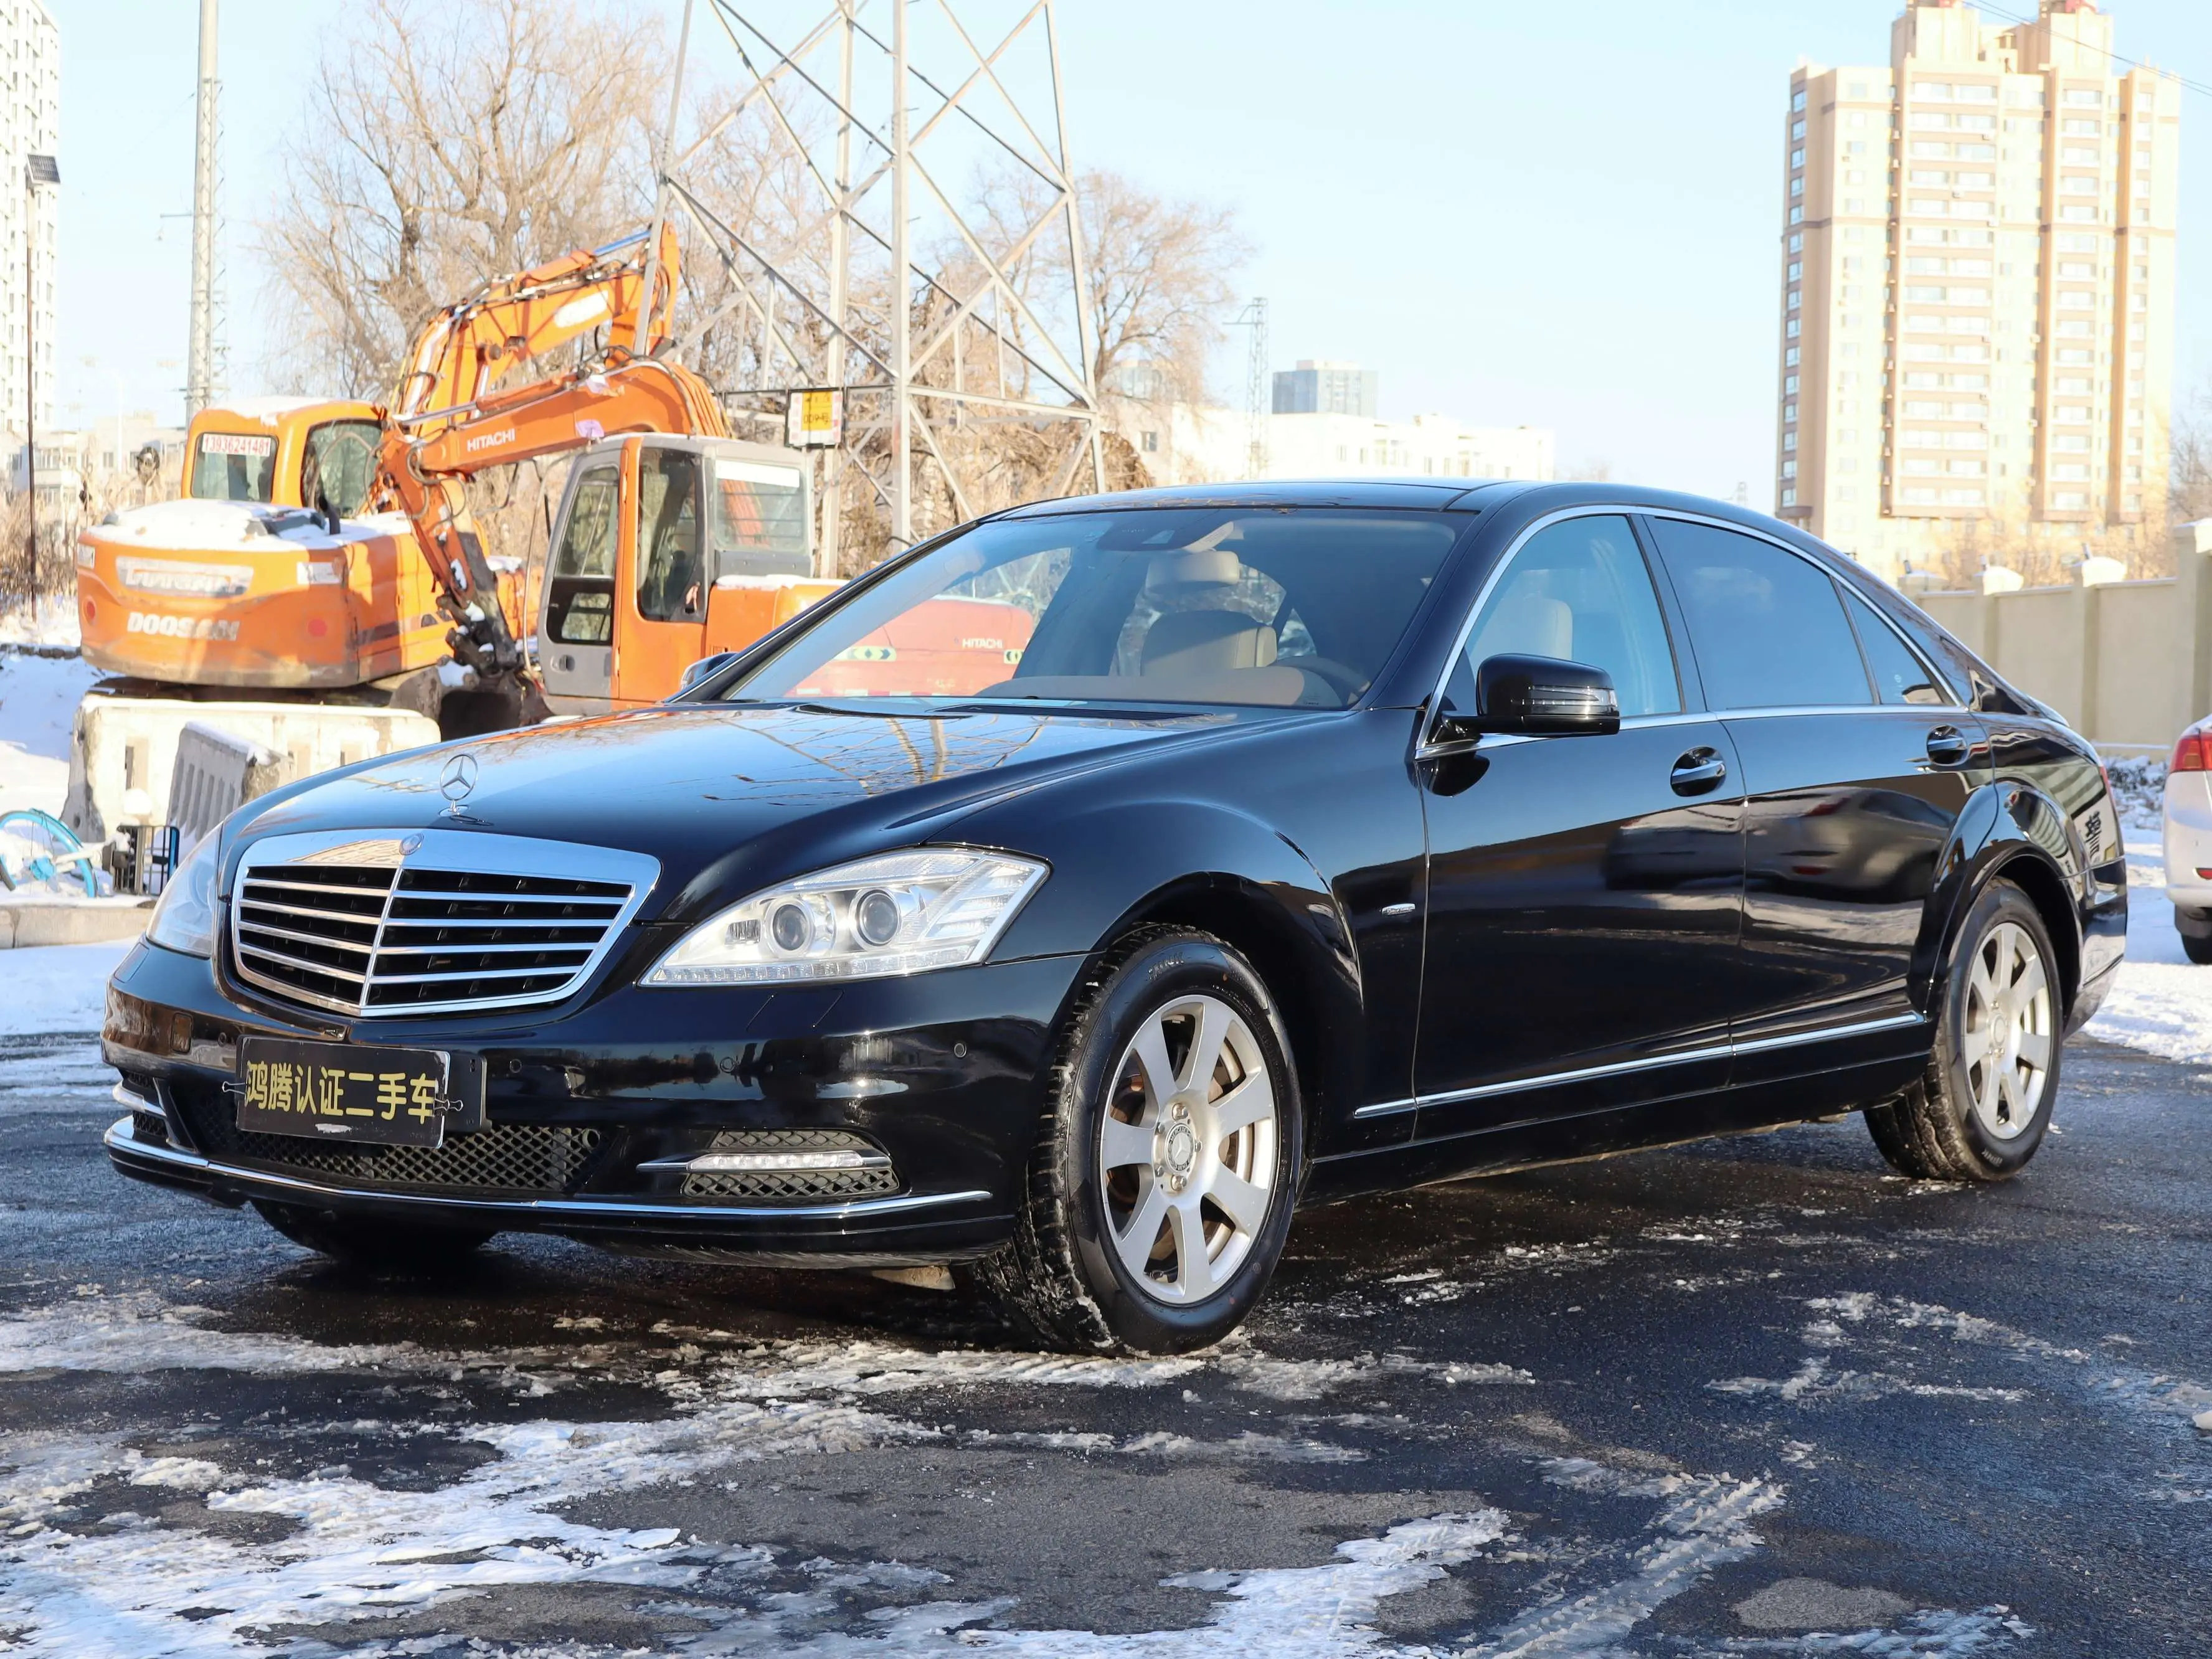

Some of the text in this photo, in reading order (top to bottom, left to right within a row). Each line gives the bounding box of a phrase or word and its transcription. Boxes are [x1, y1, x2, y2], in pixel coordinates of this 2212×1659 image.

[204, 435, 270, 455] 13936241481
[467, 428, 516, 453] HITACHI
[127, 610, 240, 641] DOOSAN
[962, 638, 1003, 649] HITACHI
[245, 1060, 438, 1125] 鸿腾认证二手车
